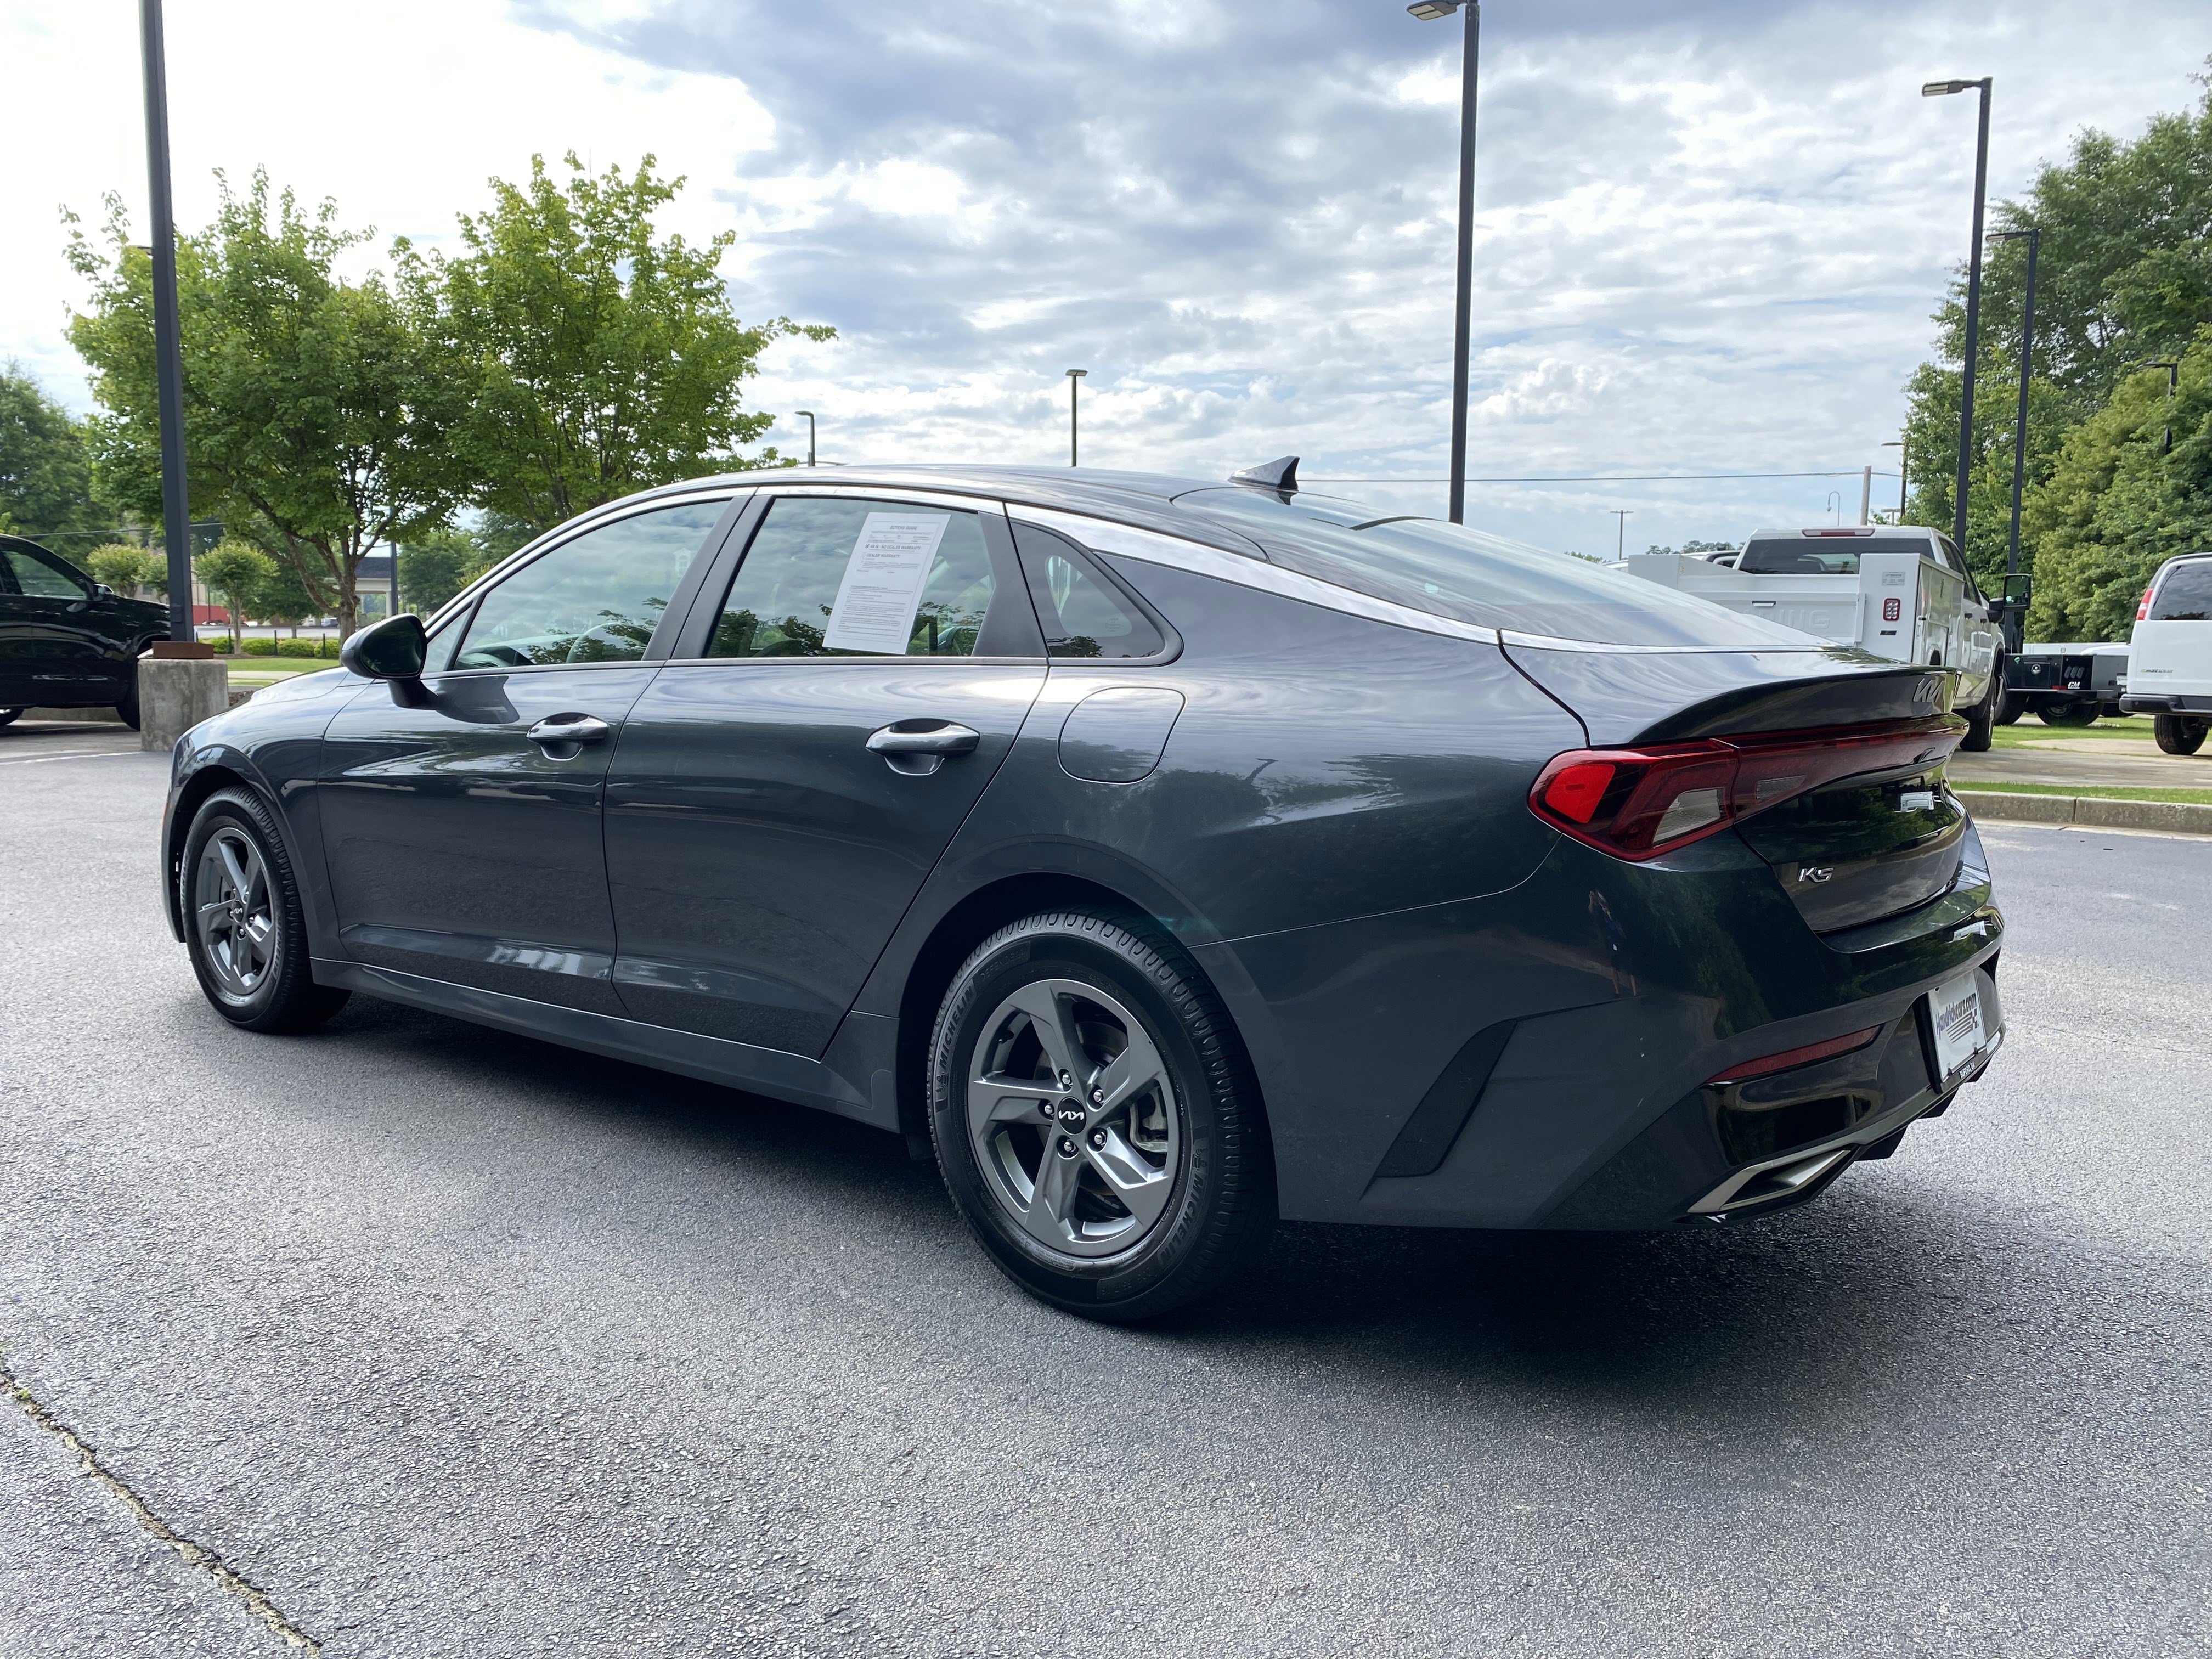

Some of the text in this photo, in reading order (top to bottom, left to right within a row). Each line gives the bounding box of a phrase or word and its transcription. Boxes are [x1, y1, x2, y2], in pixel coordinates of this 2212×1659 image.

[1798, 867, 1833, 883] K5
[940, 986, 975, 1070] MICHELIN
[1159, 1173, 1204, 1262] MICHELIN
